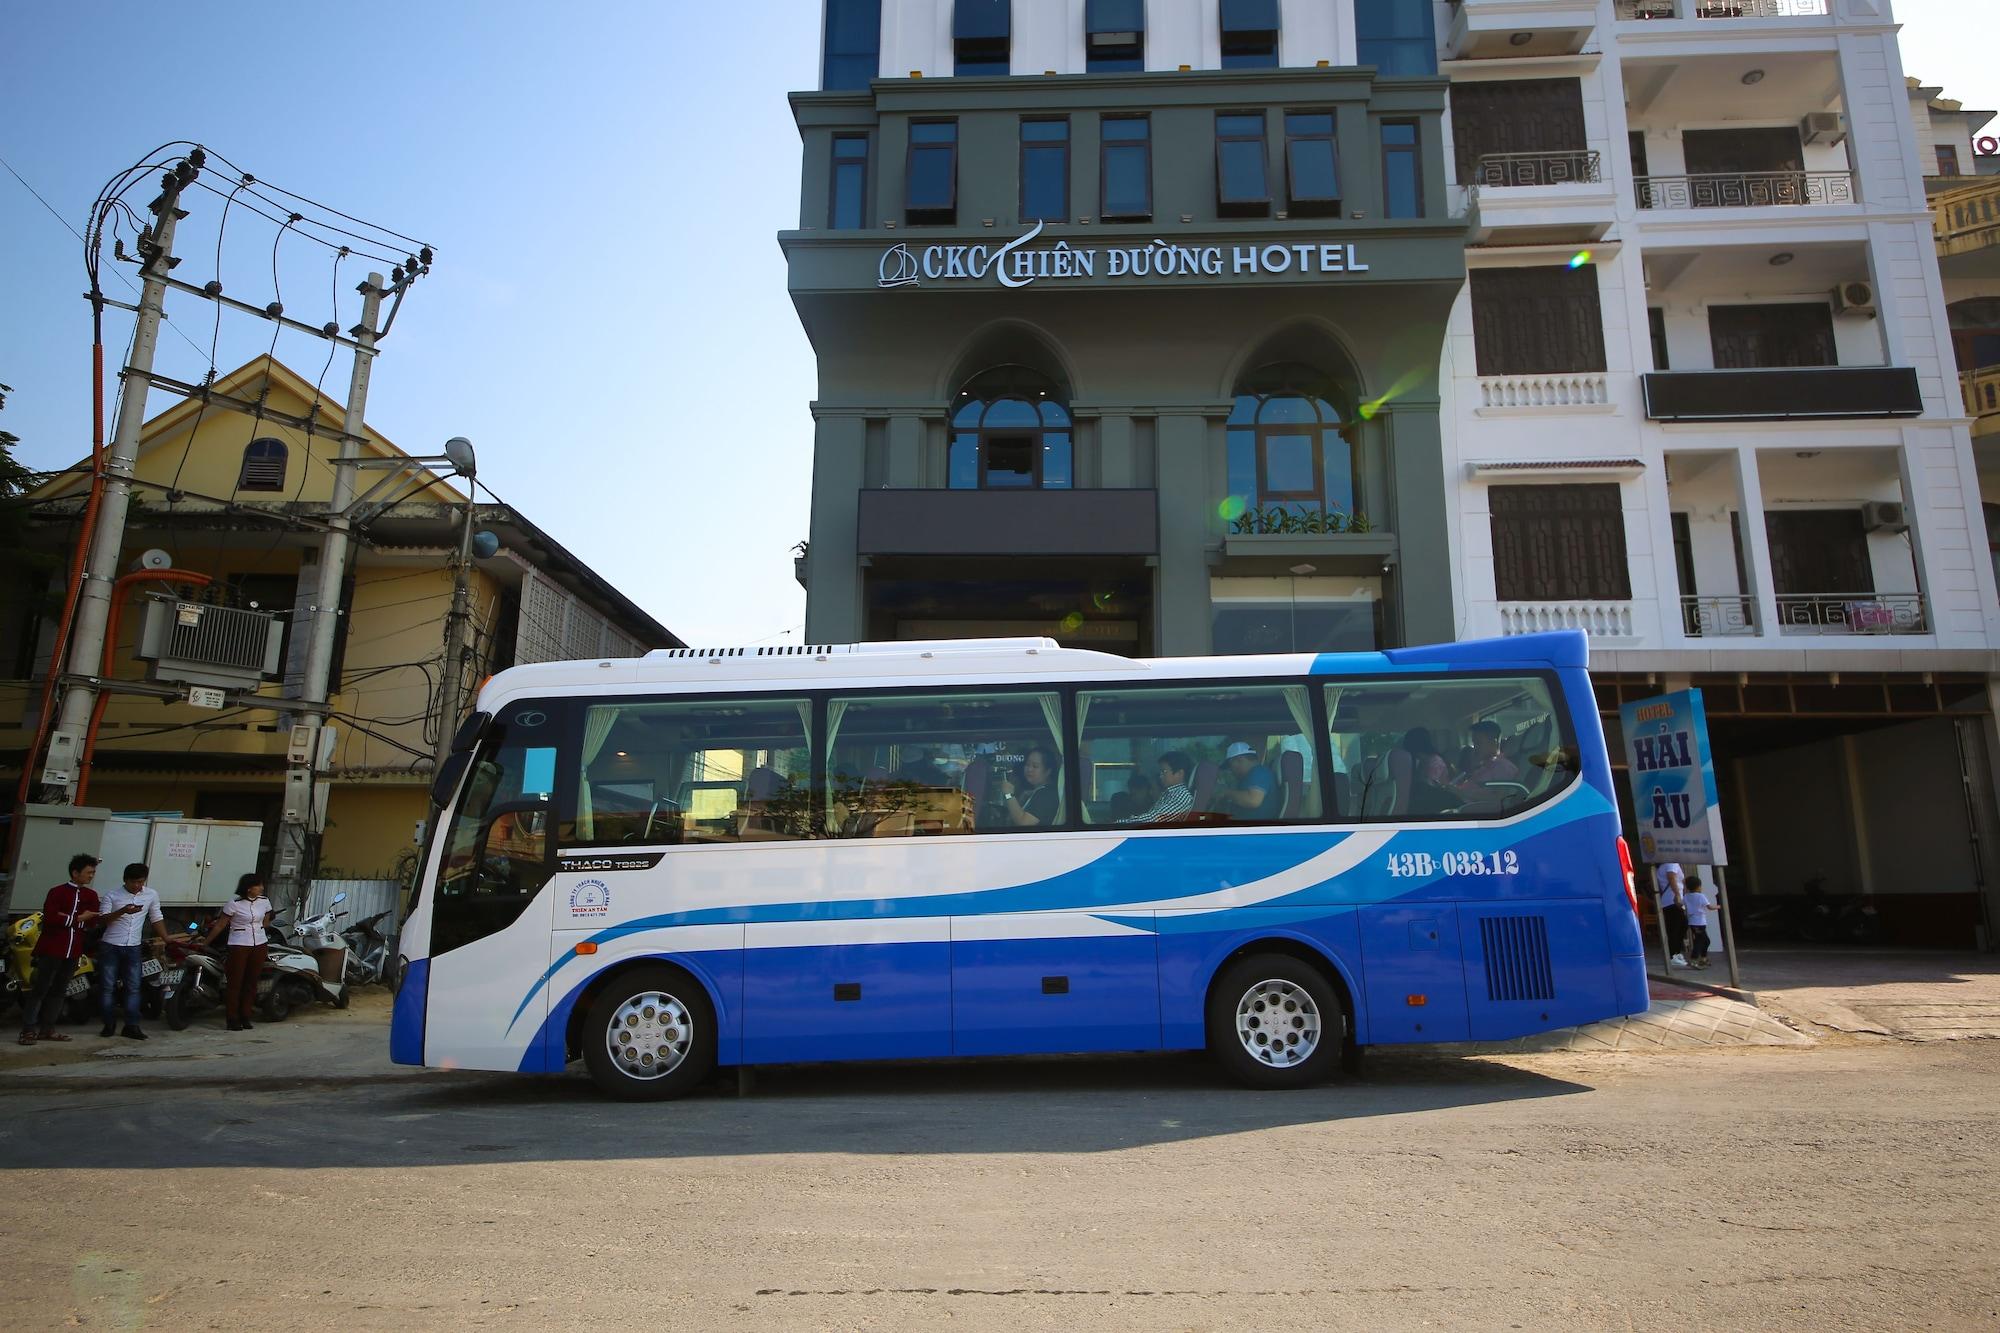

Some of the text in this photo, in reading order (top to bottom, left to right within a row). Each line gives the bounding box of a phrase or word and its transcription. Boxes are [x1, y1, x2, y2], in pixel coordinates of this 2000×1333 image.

[922, 245, 987, 279] CKC
[1107, 239, 1224, 276] ĐƯỜNG
[1233, 244, 1369, 274] HOTEL
[1636, 704, 1674, 719] HOTEL
[1634, 724, 1692, 771] HẢI
[1652, 788, 1690, 829] ÂU
[561, 860, 612, 870] THACO
